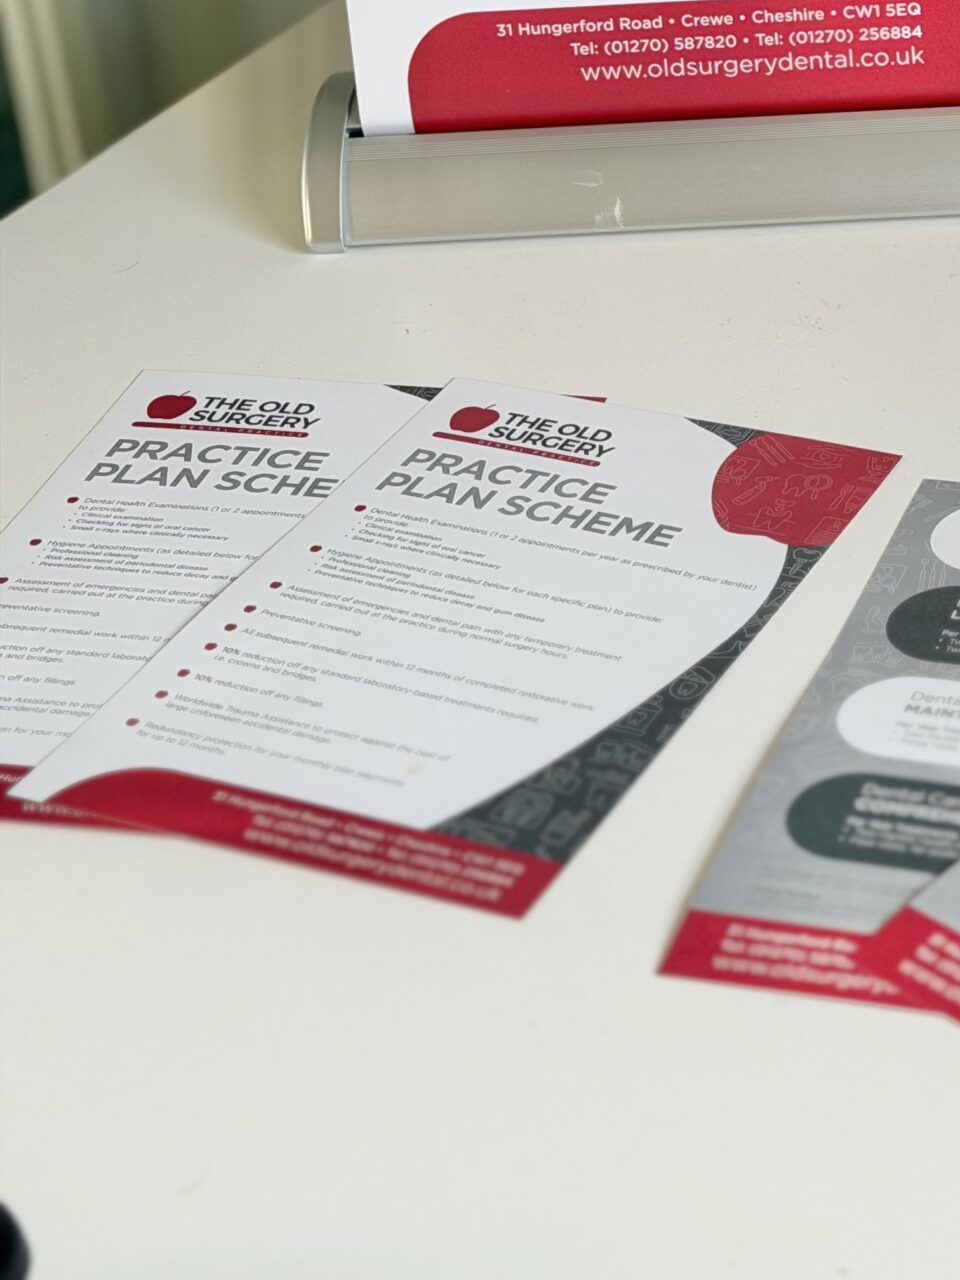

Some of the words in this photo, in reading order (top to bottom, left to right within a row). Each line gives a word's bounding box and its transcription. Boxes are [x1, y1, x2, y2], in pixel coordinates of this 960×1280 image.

[496, 23, 512, 36] 31
[518, 17, 613, 36] Hungerford
[619, 15, 662, 30] Road
[681, 14, 733, 27] Crewe
[752, 8, 824, 23] Cheshire
[843, 4, 880, 19] CW1
[886, 2, 921, 16] 5EQ
[570, 42, 598, 55] Tel:
[604, 38, 668, 55] (01270)
[674, 34, 736, 50] 587820
[754, 32, 783, 45] Tel:
[788, 29, 853, 46] (01270)
[859, 25, 922, 41] 256884
[580, 45, 924, 80] www.oldsurgerydental.co.uk
[188, 410, 320, 428] SURGERY
[203, 396, 257, 411] THE
[258, 401, 314, 414] OLD
[488, 426, 615, 457] SURGERY
[505, 412, 557, 432] THE
[557, 424, 612, 441] OLD
[105, 438, 330, 471] PRACTICE
[84, 462, 210, 488] PLAN
[213, 471, 339, 498] SCHE
[400, 448, 617, 504] PRACTICE
[375, 471, 497, 509] PLAN
[497, 495, 682, 547] SCHEME
[326, 548, 363, 560] Hygiene
[363, 556, 427, 573] Appointments
[444, 573, 482, 584] detailed
[481, 580, 510, 590] below
[526, 590, 549, 599] each
[549, 596, 585, 607] specific
[586, 603, 611, 612] plan)
